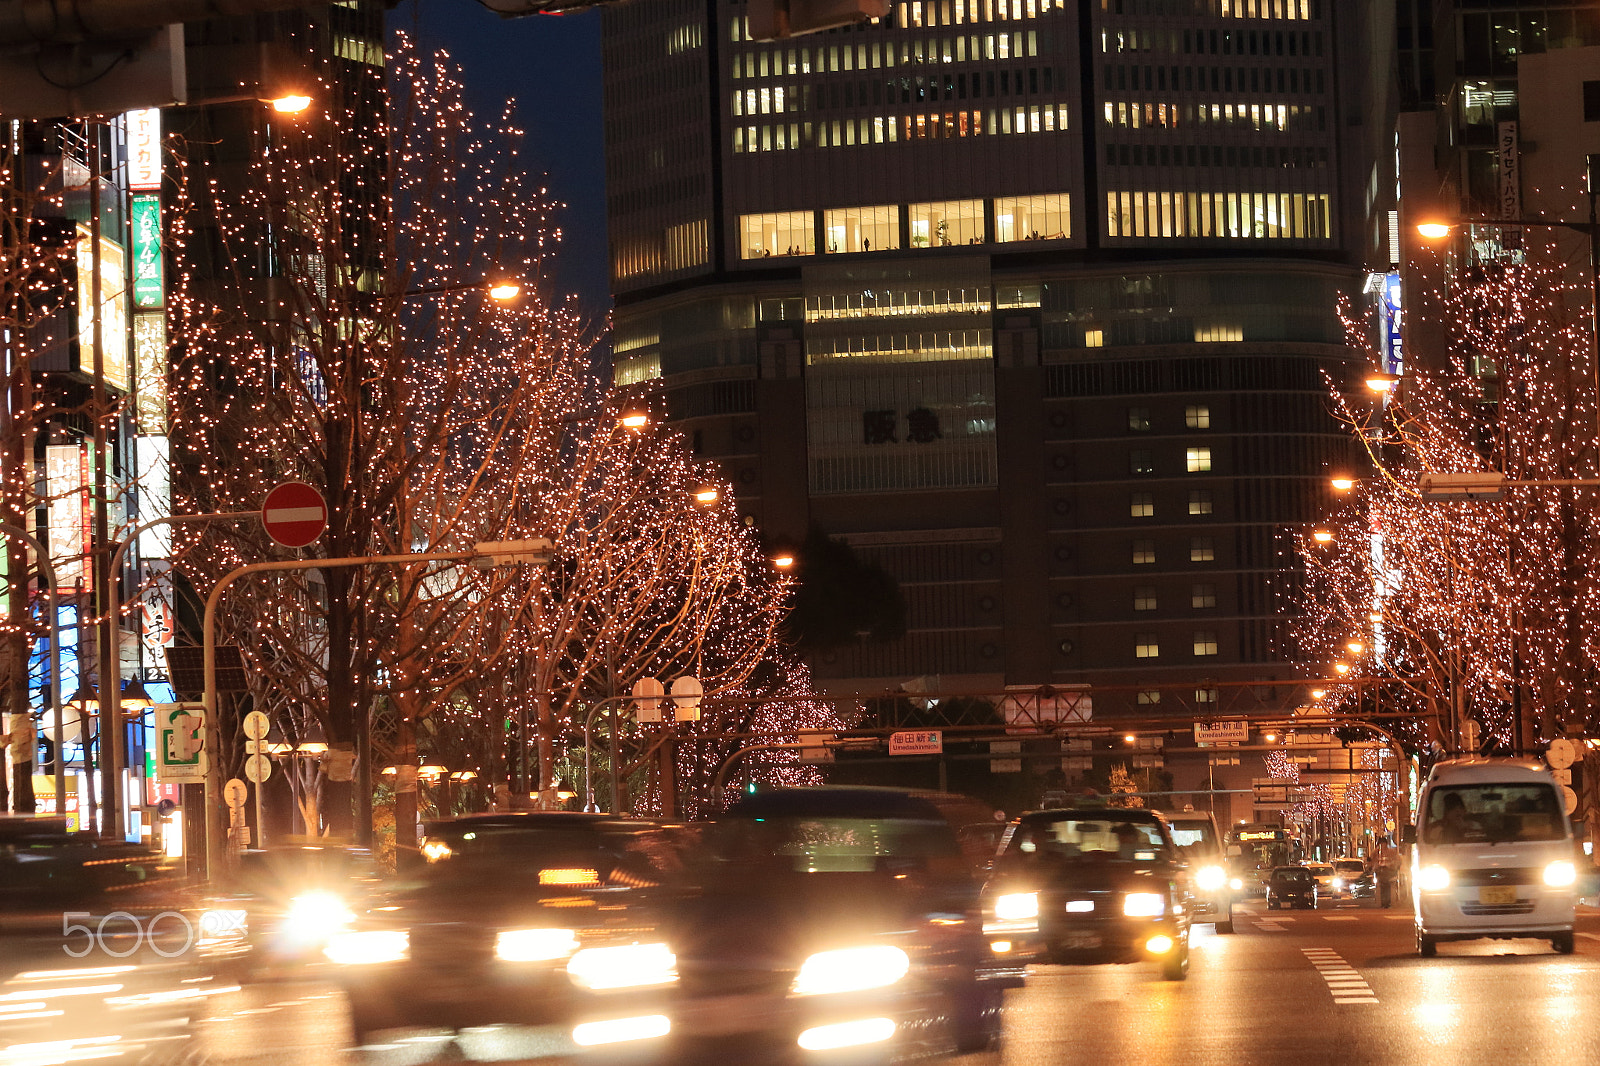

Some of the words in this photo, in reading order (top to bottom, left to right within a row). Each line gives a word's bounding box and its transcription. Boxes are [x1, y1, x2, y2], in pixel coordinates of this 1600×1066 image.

[142, 295, 156, 305] 4F
[894, 732, 938, 744] 梅田新道
